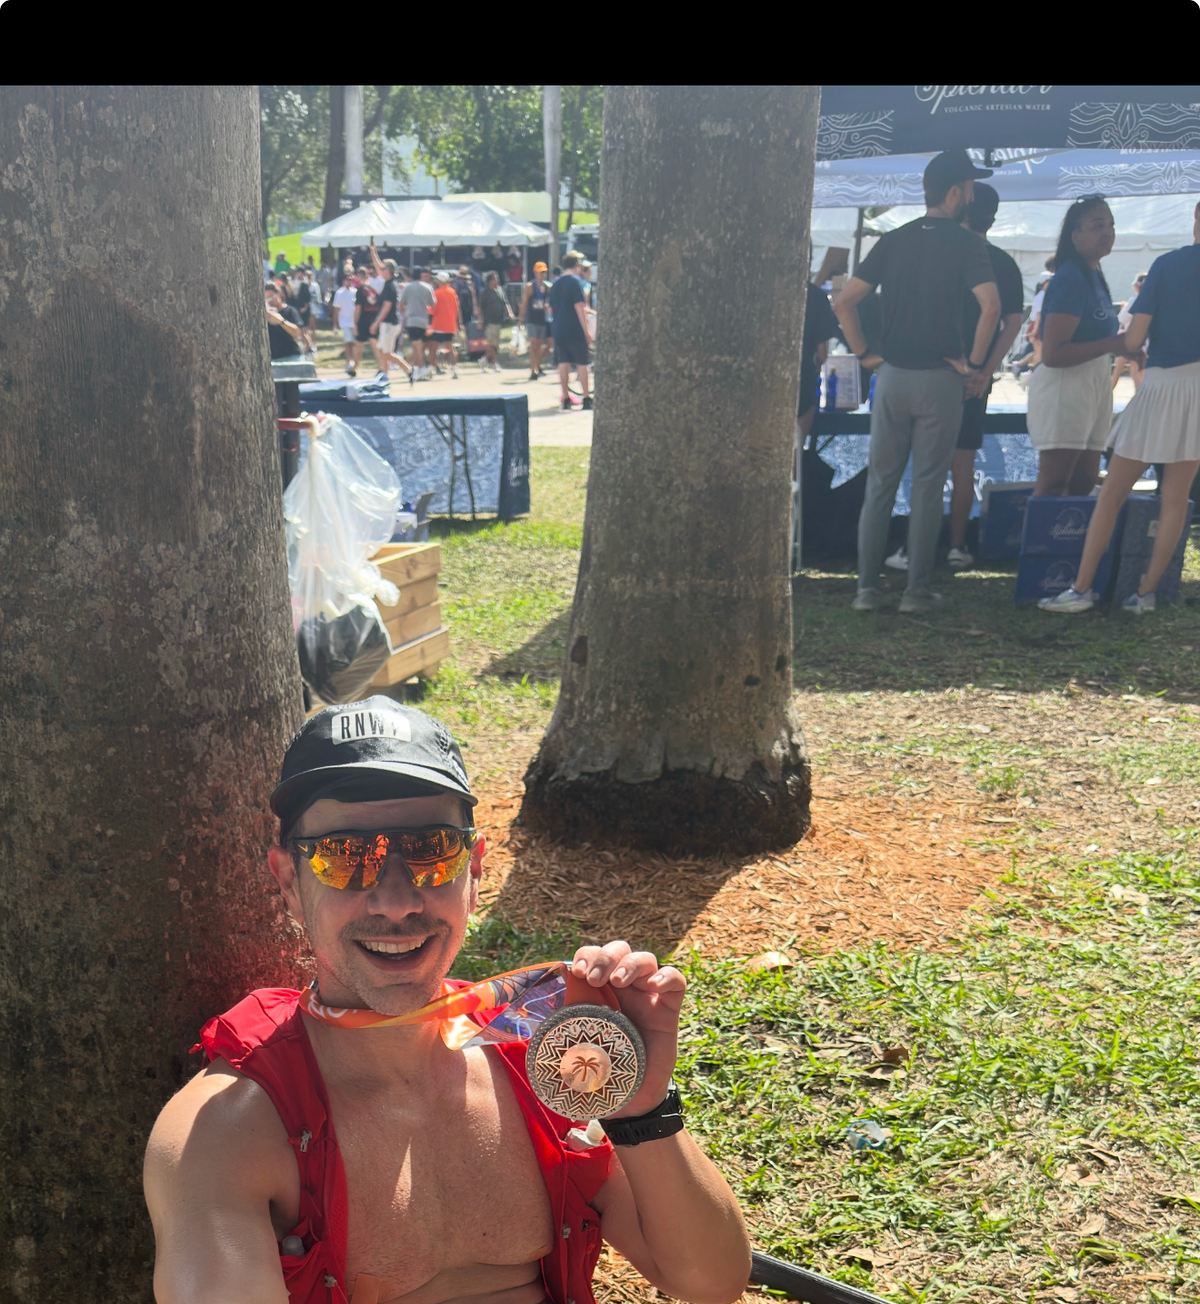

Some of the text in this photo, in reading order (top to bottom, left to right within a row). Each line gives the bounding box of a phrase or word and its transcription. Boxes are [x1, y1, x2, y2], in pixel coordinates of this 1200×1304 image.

[914, 86, 1052, 115] Spenr
[944, 103, 1051, 113] VOLCANIC ARTESIAN WATER
[555, 1024, 624, 1048] MIAMI
